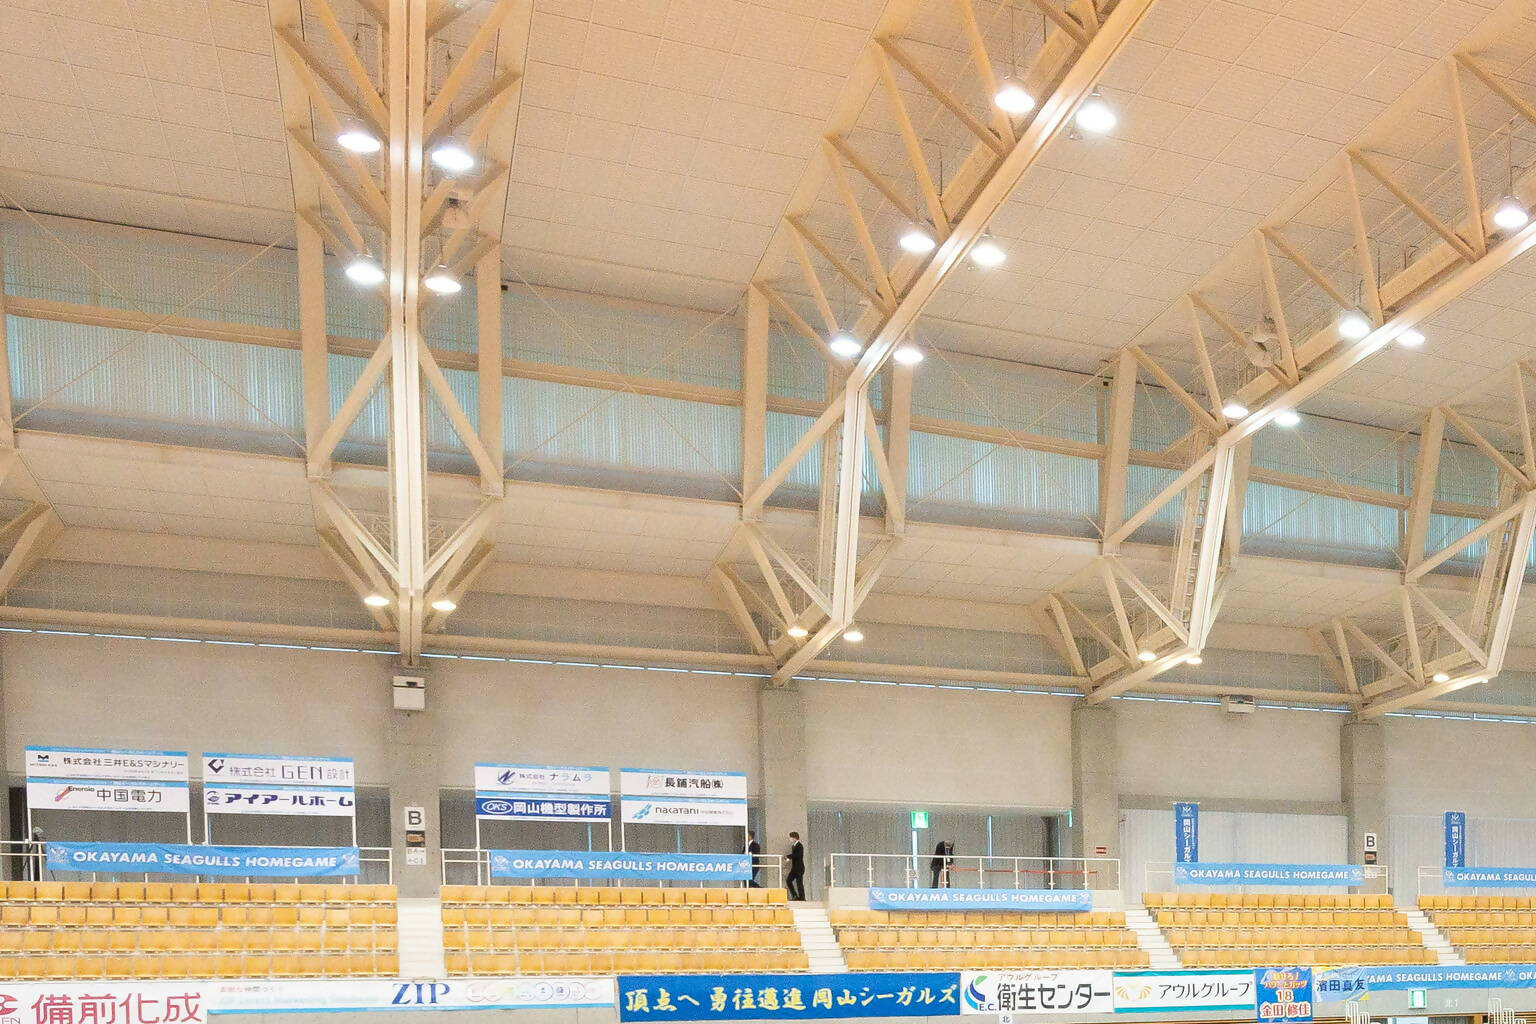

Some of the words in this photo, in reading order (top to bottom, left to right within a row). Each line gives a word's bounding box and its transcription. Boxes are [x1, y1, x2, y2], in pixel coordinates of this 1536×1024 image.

[281, 765, 323, 780] GEN
[97, 788, 162, 803] 中国電力
[408, 810, 422, 825] B
[1366, 836, 1375, 847] B
[73, 850, 158, 864] OKAYAMA
[164, 853, 240, 867] SEAGULLS
[246, 856, 337, 867] HOMEGAME
[513, 859, 584, 871] OKAYAMA
[588, 860, 652, 872] SEAGULLS
[656, 862, 733, 873] HOMEGAME
[1190, 870, 1241, 878] OKAYAMA
[1244, 871, 1290, 880] SEAGULLS
[1293, 872, 1349, 880] HOMEGAME
[1456, 872, 1501, 882] OKAYAMA
[888, 893, 947, 903] OKAYAMA
[952, 892, 1007, 904] SEAGULLS
[1011, 892, 1077, 904] HOMEGAME
[1396, 973, 1443, 983] SEAGULLS
[1446, 971, 1502, 982] HOMEGAME
[391, 982, 451, 1005] ZIP
[998, 983, 1111, 1011] 衛生センター
[1159, 981, 1253, 1000] アウルグループ
[1276, 990, 1294, 1002] 18
